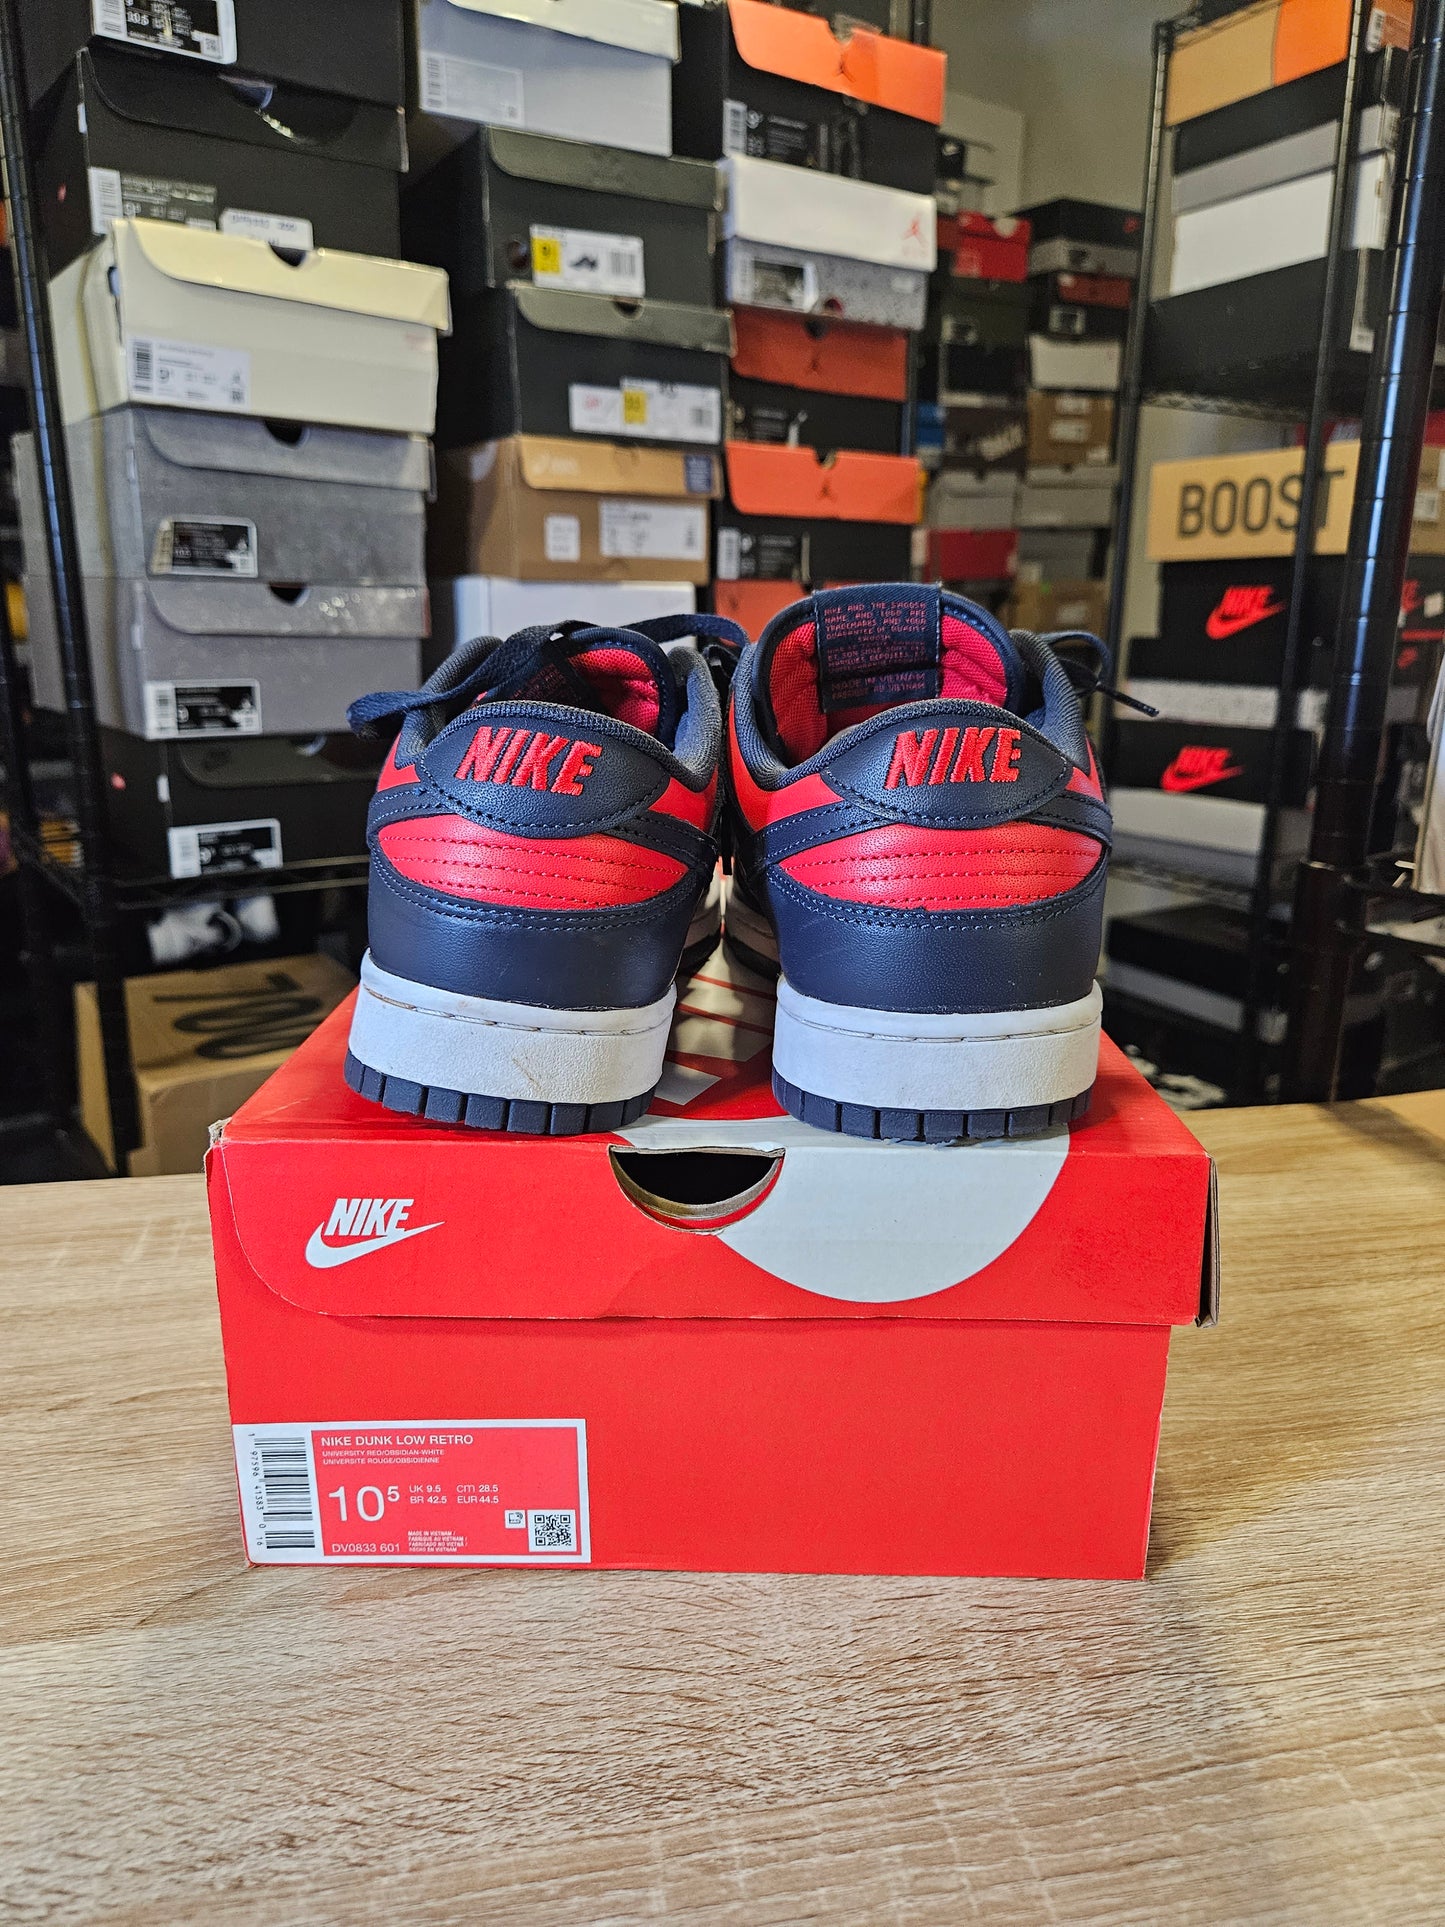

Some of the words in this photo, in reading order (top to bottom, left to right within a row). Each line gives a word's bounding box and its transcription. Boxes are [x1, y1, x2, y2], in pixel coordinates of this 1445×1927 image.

[1177, 468, 1345, 539] BOOST
[1220, 584, 1274, 618] NIKE
[824, 607, 842, 616] NIKE
[847, 604, 865, 612] AND
[890, 601, 926, 609] SWOOSH
[825, 615, 847, 624] NAME
[855, 611, 873, 619] AND
[826, 620, 877, 632] TRADEMARKS
[883, 618, 901, 626] AND
[905, 618, 926, 626] YOUR
[890, 624, 926, 633] QUALITY
[880, 672, 926, 683] VIETNAM
[454, 725, 603, 796] NIKE
[883, 726, 1022, 791] NIKE
[323, 1197, 415, 1237] NIKE
[321, 1436, 352, 1447] NIKE
[355, 1435, 392, 1446] DUNK
[396, 1434, 426, 1445] LOW
[429, 1434, 474, 1445] RETRO
[322, 1449, 365, 1457] UNIVERSITY
[366, 1448, 444, 1456] RED/OBSIDIAN-WHITE
[250, 1450, 260, 1477] 97596
[409, 1484, 424, 1493] UK
[426, 1484, 441, 1493] 9.5
[478, 1484, 499, 1493] 28.5
[254, 1485, 264, 1511] 41383
[410, 1495, 424, 1504] BR
[426, 1495, 447, 1504] 42.5
[457, 1495, 478, 1504] EUR
[478, 1495, 499, 1504] 44.5
[331, 1543, 377, 1553] DV0833
[379, 1543, 401, 1553] 601
